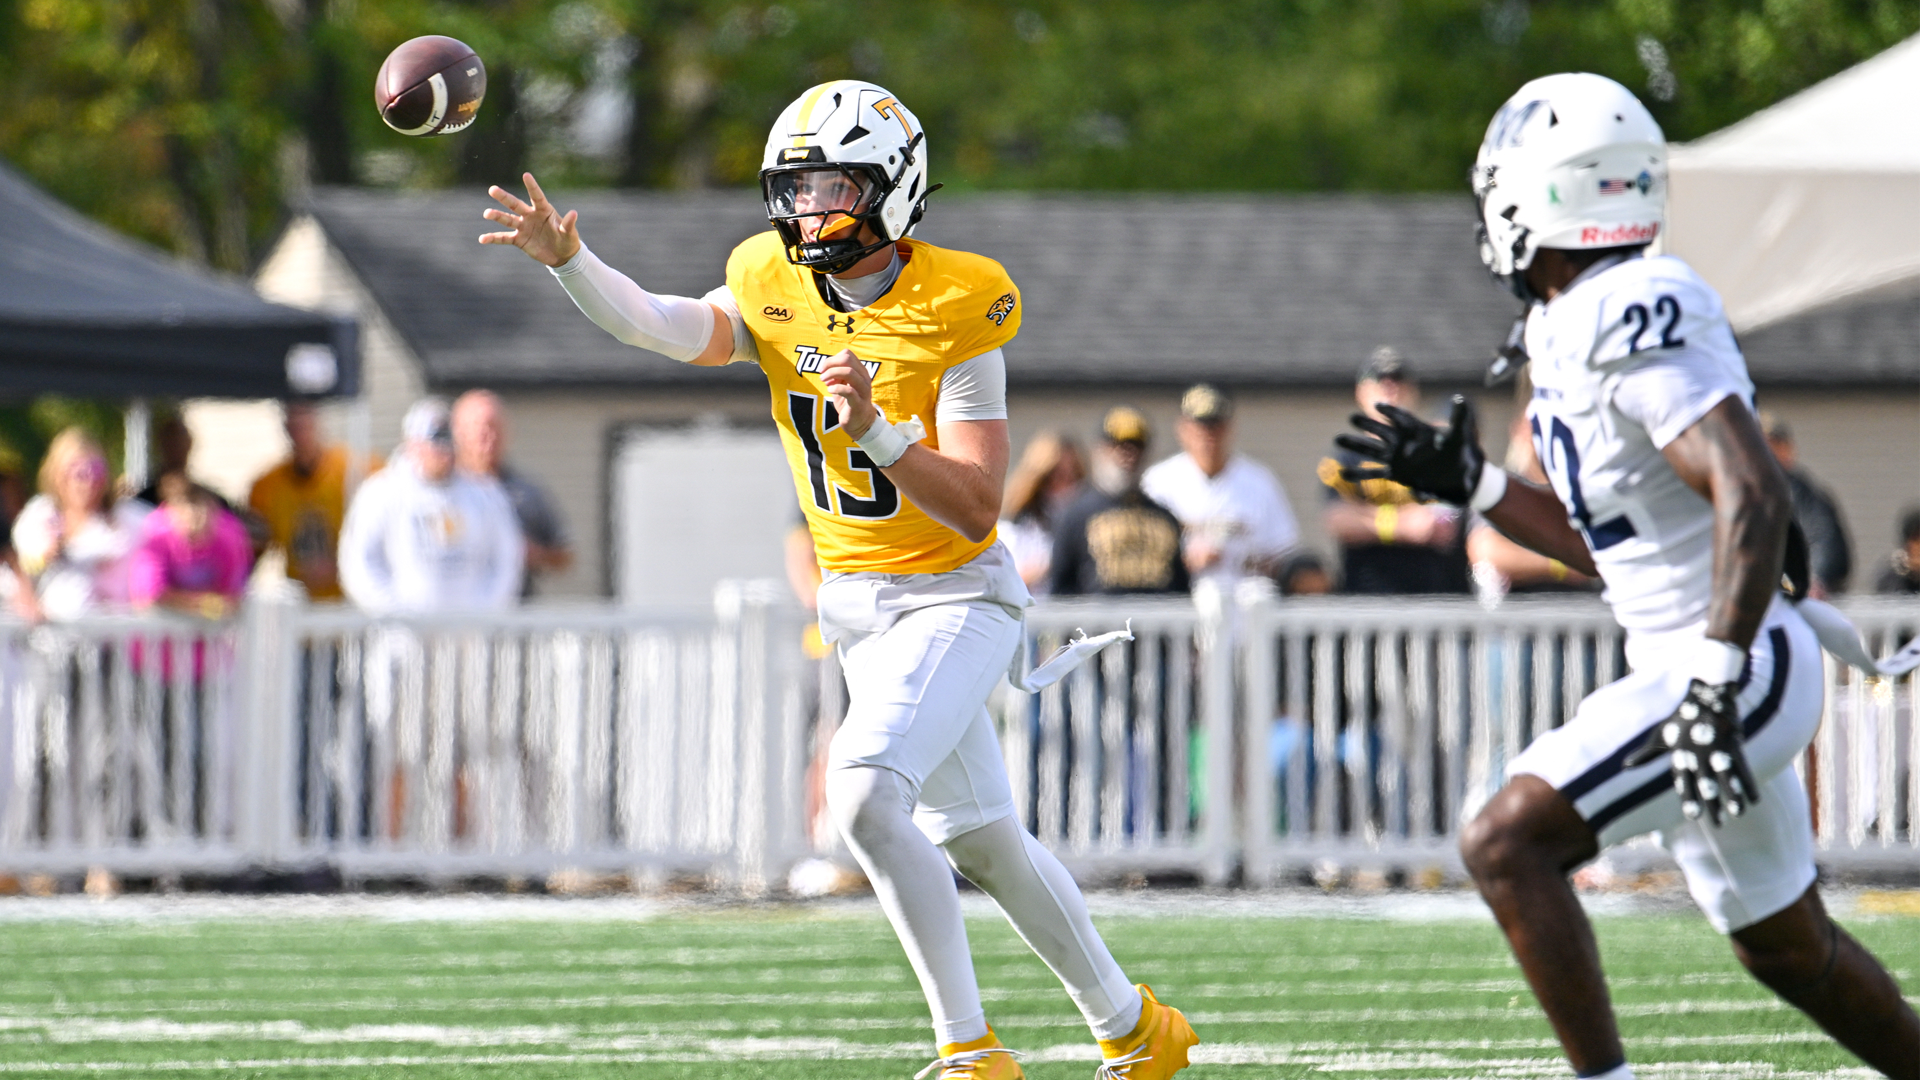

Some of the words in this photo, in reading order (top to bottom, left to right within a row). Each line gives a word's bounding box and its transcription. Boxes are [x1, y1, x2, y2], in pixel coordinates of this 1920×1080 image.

[763, 306, 787, 318] CAA
[1623, 294, 1685, 356] 22
[787, 389, 900, 520] 13
